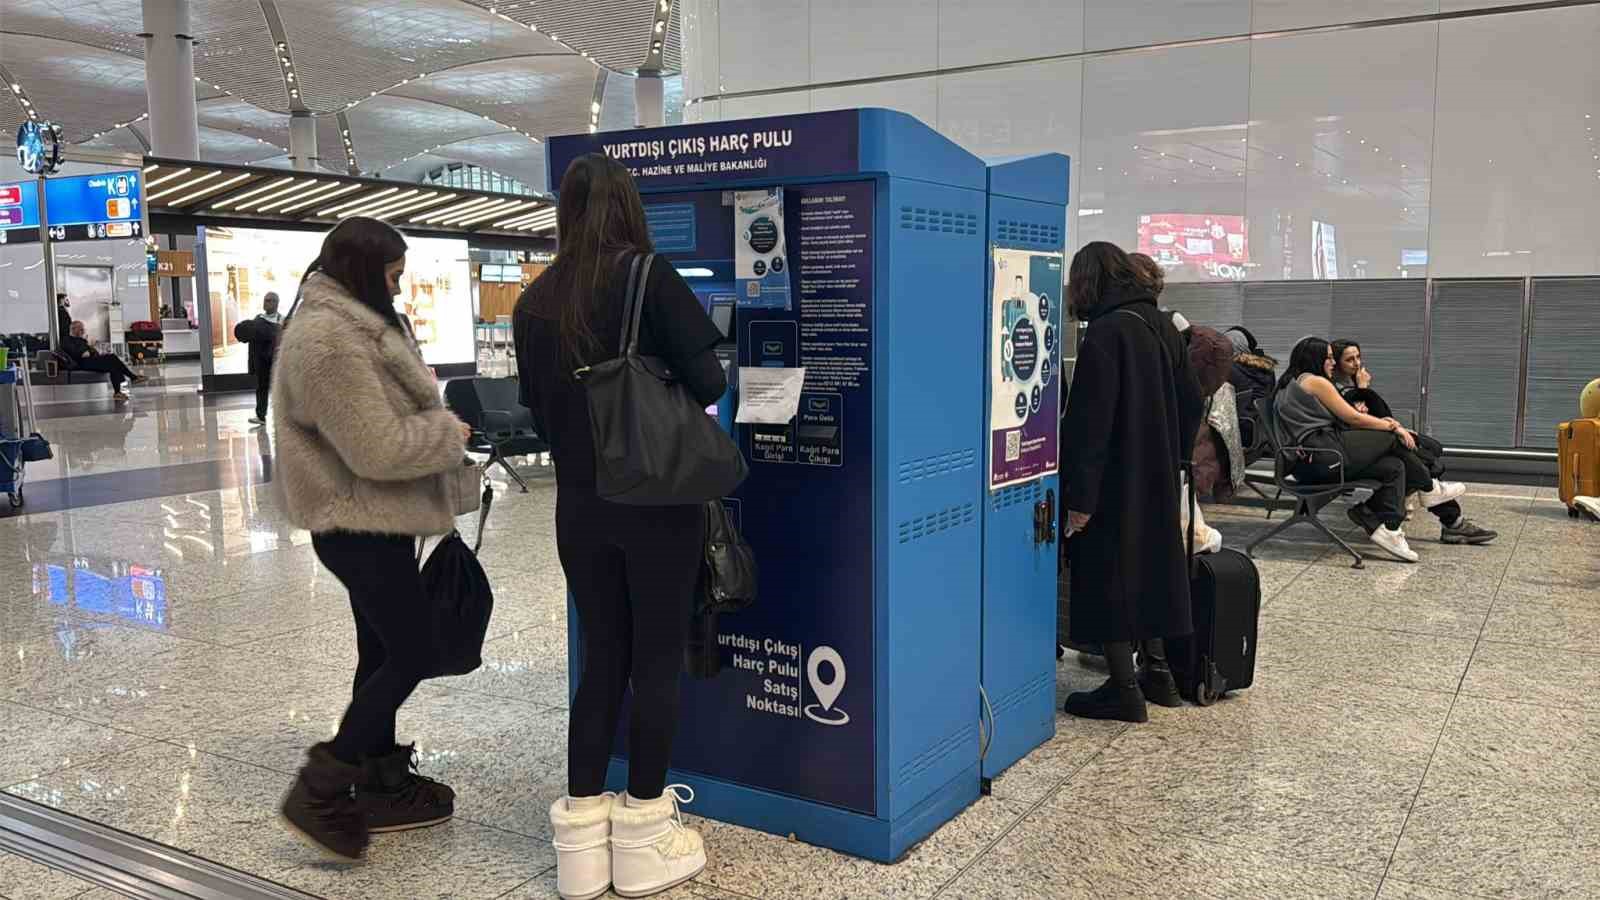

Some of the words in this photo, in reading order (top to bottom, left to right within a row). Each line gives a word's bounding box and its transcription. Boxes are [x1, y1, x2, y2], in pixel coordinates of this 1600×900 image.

[603, 141, 665, 161] YURTDIŞI
[668, 136, 706, 159] ÇIKIŞ
[710, 133, 749, 154] HARÇ
[753, 129, 793, 149] PULU
[642, 164, 672, 177] HAZİNE
[674, 164, 685, 174] VE
[687, 160, 718, 173] MALİYE
[720, 157, 768, 171] BAKANLIĞI
[107, 178, 116, 195] K
[822, 446, 840, 456] Para
[718, 633, 760, 652] urtdışı
[764, 638, 798, 660] Çıkış
[733, 654, 765, 674] Harç
[769, 660, 798, 677] Pulu
[764, 679, 798, 701] Satış
[746, 695, 799, 717] Noktası
